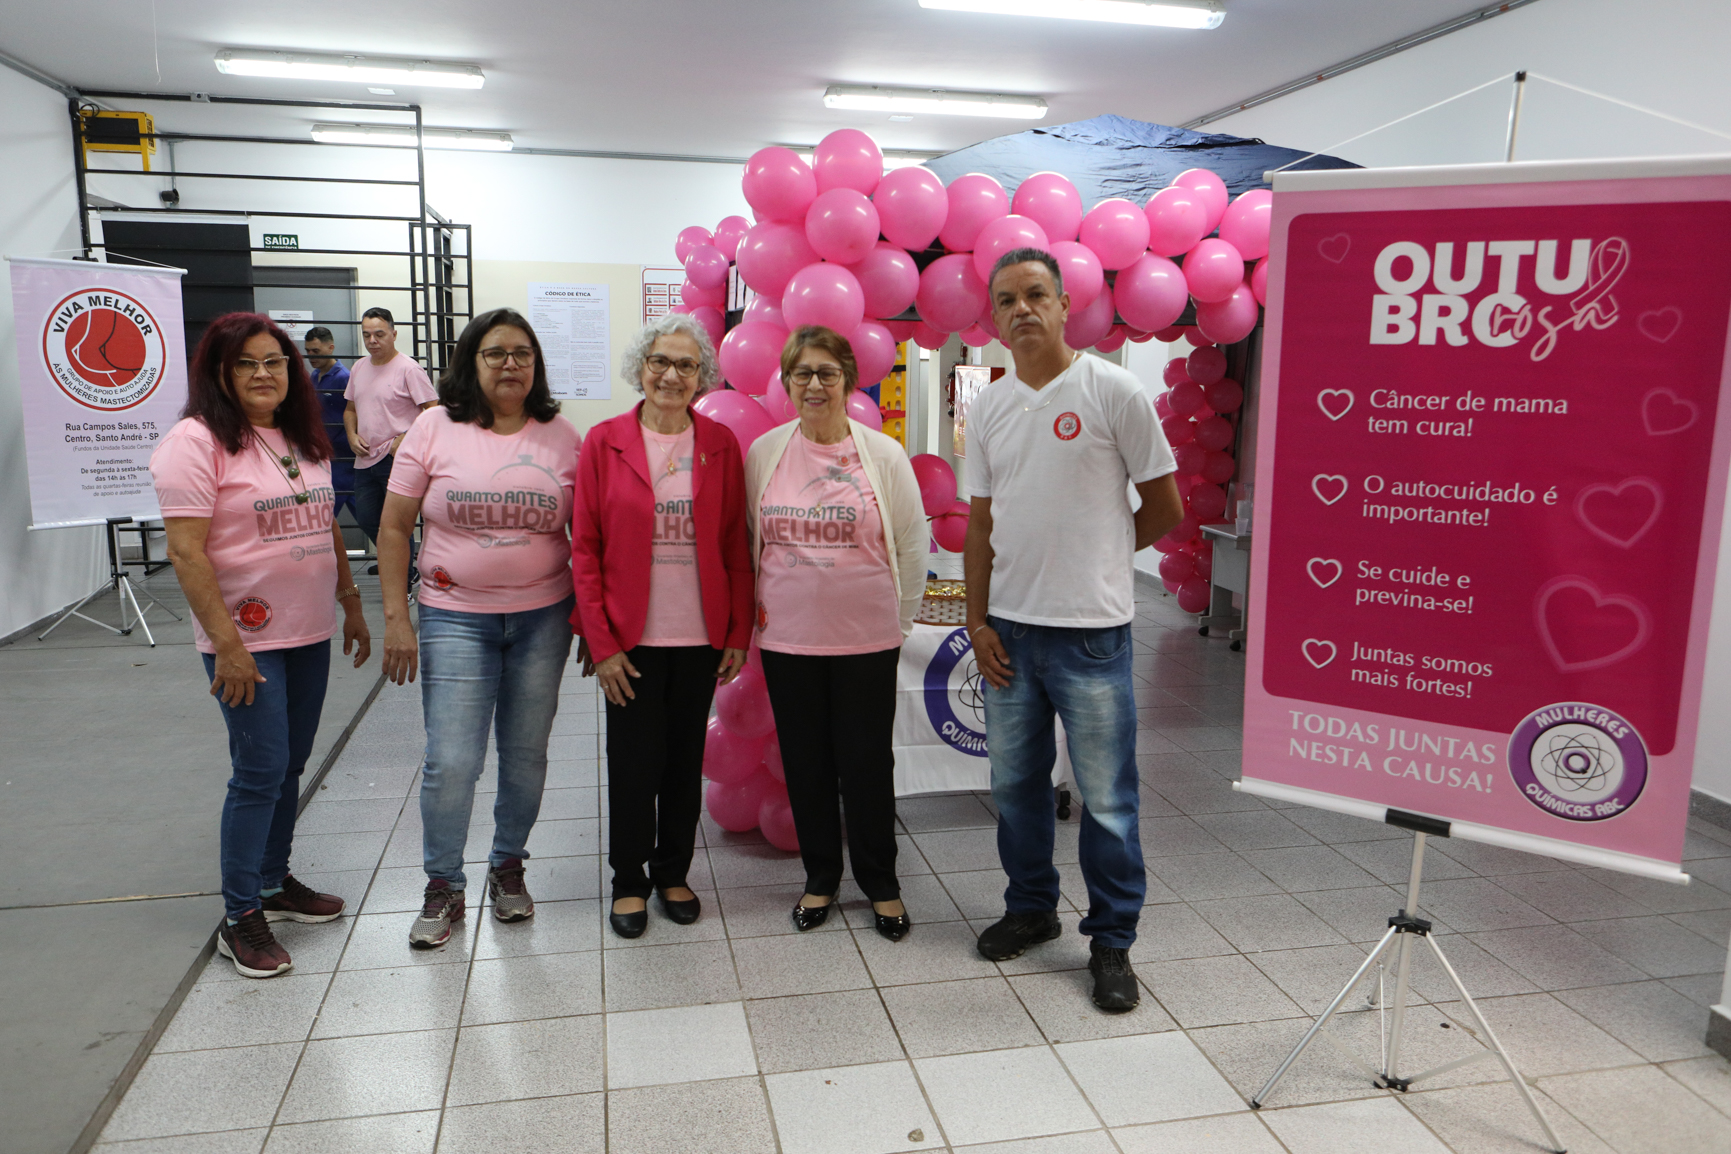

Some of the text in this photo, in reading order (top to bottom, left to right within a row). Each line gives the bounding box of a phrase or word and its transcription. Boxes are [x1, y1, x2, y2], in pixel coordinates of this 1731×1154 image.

[264, 235, 297, 245] SAÍDA
[1374, 238, 1592, 295] OUTU
[53, 296, 152, 336] VIVA MELHOR
[60, 373, 98, 402] MULHERES
[100, 367, 157, 405] MASTECTOMIZADAS
[67, 368, 84, 386] GRUPO
[84, 383, 93, 392] DE
[120, 384, 134, 393] AUTO
[134, 369, 149, 385] AJUDA
[1370, 389, 1568, 415] Câncer de mama
[82, 423, 116, 432] Campos
[142, 422, 157, 430] 575,
[1368, 416, 1473, 437] tem cura!
[446, 490, 557, 510] QUANTO ANTES
[1363, 475, 1558, 505] O autocuidado é
[253, 496, 297, 512] QUANT
[447, 502, 556, 530] MELHOR
[666, 500, 693, 516] ANT
[762, 506, 806, 517] QUANTO
[1362, 500, 1490, 527] importante!
[762, 518, 856, 543] MELHOR
[1357, 560, 1471, 589] Se cuide e
[1355, 587, 1474, 614] previna-se!
[1350, 641, 1493, 677] Juntas somos
[1351, 668, 1472, 698] mais fortes!
[1535, 706, 1629, 739] MULHERES
[1288, 710, 1496, 765] TODAS JUNTAS
[1289, 738, 1494, 794] NESTA CAUSA!
[1526, 783, 1624, 817] QUÍMICAS ABC
